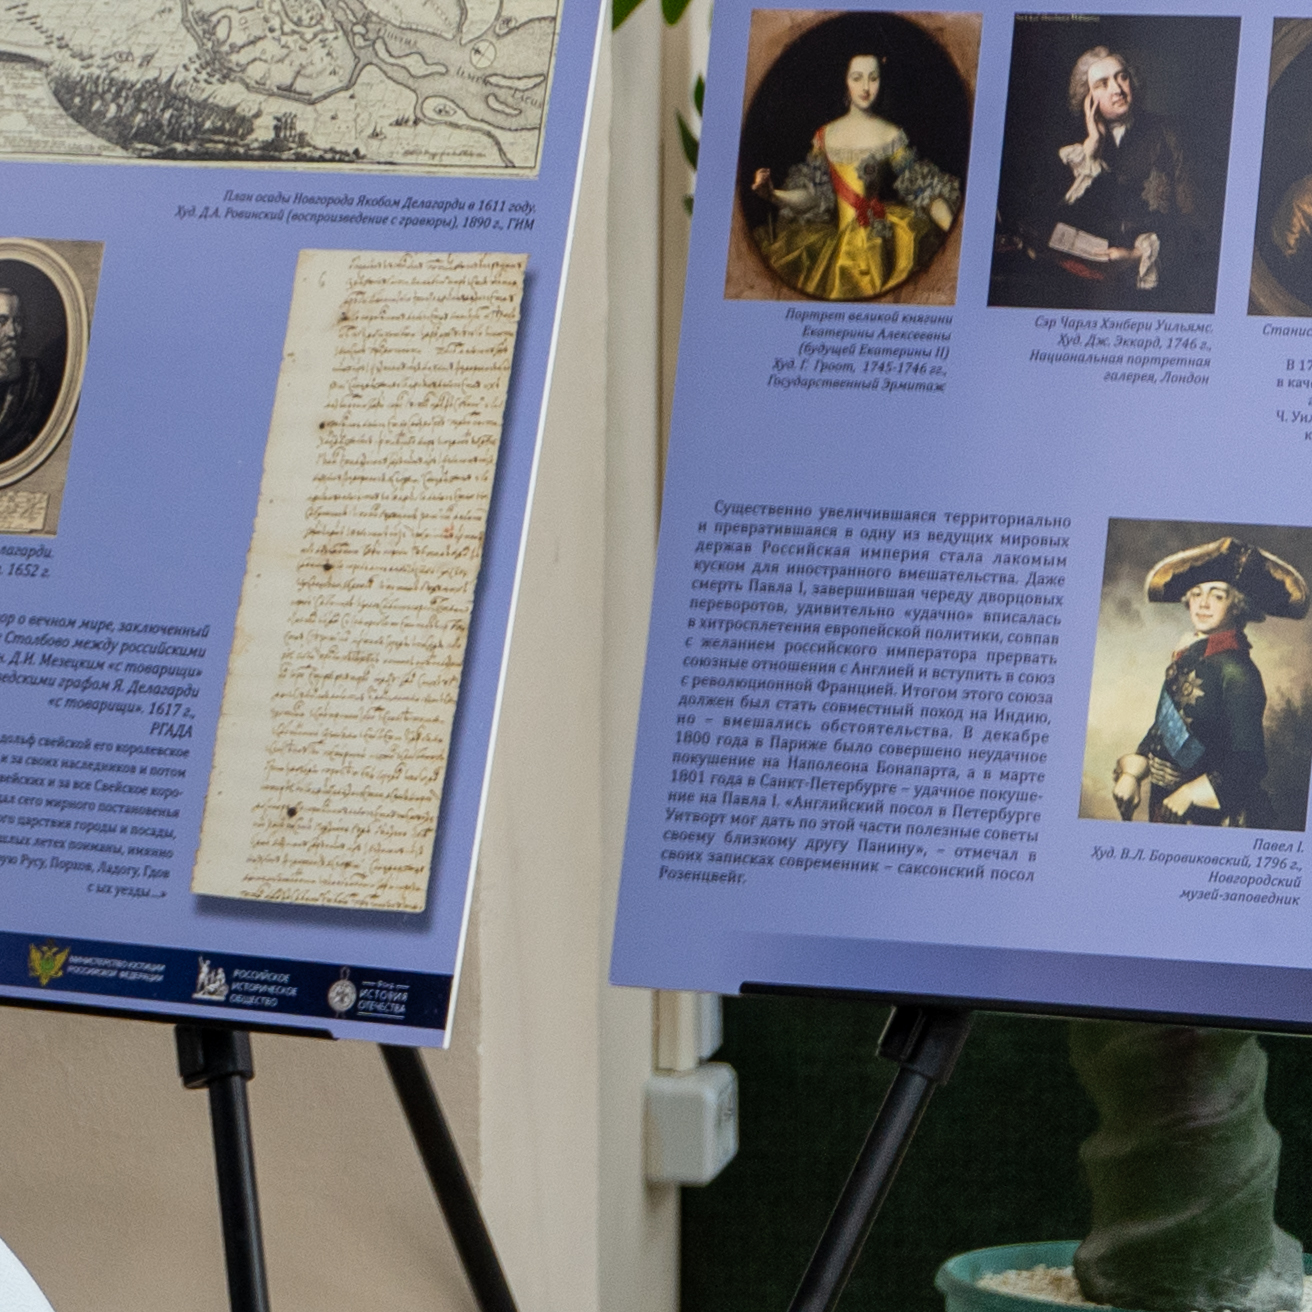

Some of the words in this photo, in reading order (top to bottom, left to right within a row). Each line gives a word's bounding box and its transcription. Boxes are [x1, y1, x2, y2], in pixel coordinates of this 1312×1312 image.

[222, 189, 253, 202] План
[254, 191, 291, 203] осады
[292, 192, 356, 208] Новгорода
[356, 194, 401, 209] Якобом
[401, 196, 465, 212] Делагарди
[477, 199, 505, 212] 1611
[224, 206, 284, 220] Ровинский
[285, 209, 388, 225] (воспроизведение
[462, 215, 491, 228] 1890
[506, 217, 534, 230] ГИМ
[1034, 315, 1056, 329] Сэр
[1060, 316, 1097, 330] Чарлз
[1099, 317, 1152, 333] Хэнбери
[1166, 337, 1196, 350] 1746
[1029, 349, 1123, 364] Национальная
[1126, 355, 1210, 368] портретная
[1159, 370, 1209, 384] Лондон
[714, 499, 812, 516] Существенно
[818, 507, 936, 522] увеличившаяся
[943, 512, 1071, 528] территориально
[28, 615, 76, 628] вечном
[117, 621, 210, 637] заключенный
[1252, 837, 1293, 852] Павел
[1090, 845, 1116, 860] Худ.
[1120, 847, 1145, 860] В.Л.
[1148, 849, 1251, 868] Боровиковский,
[1255, 856, 1287, 869] 1796
[1289, 861, 1302, 871] г.,
[1207, 870, 1301, 887] Новгородский
[1179, 888, 1300, 905] музей-заповедник
